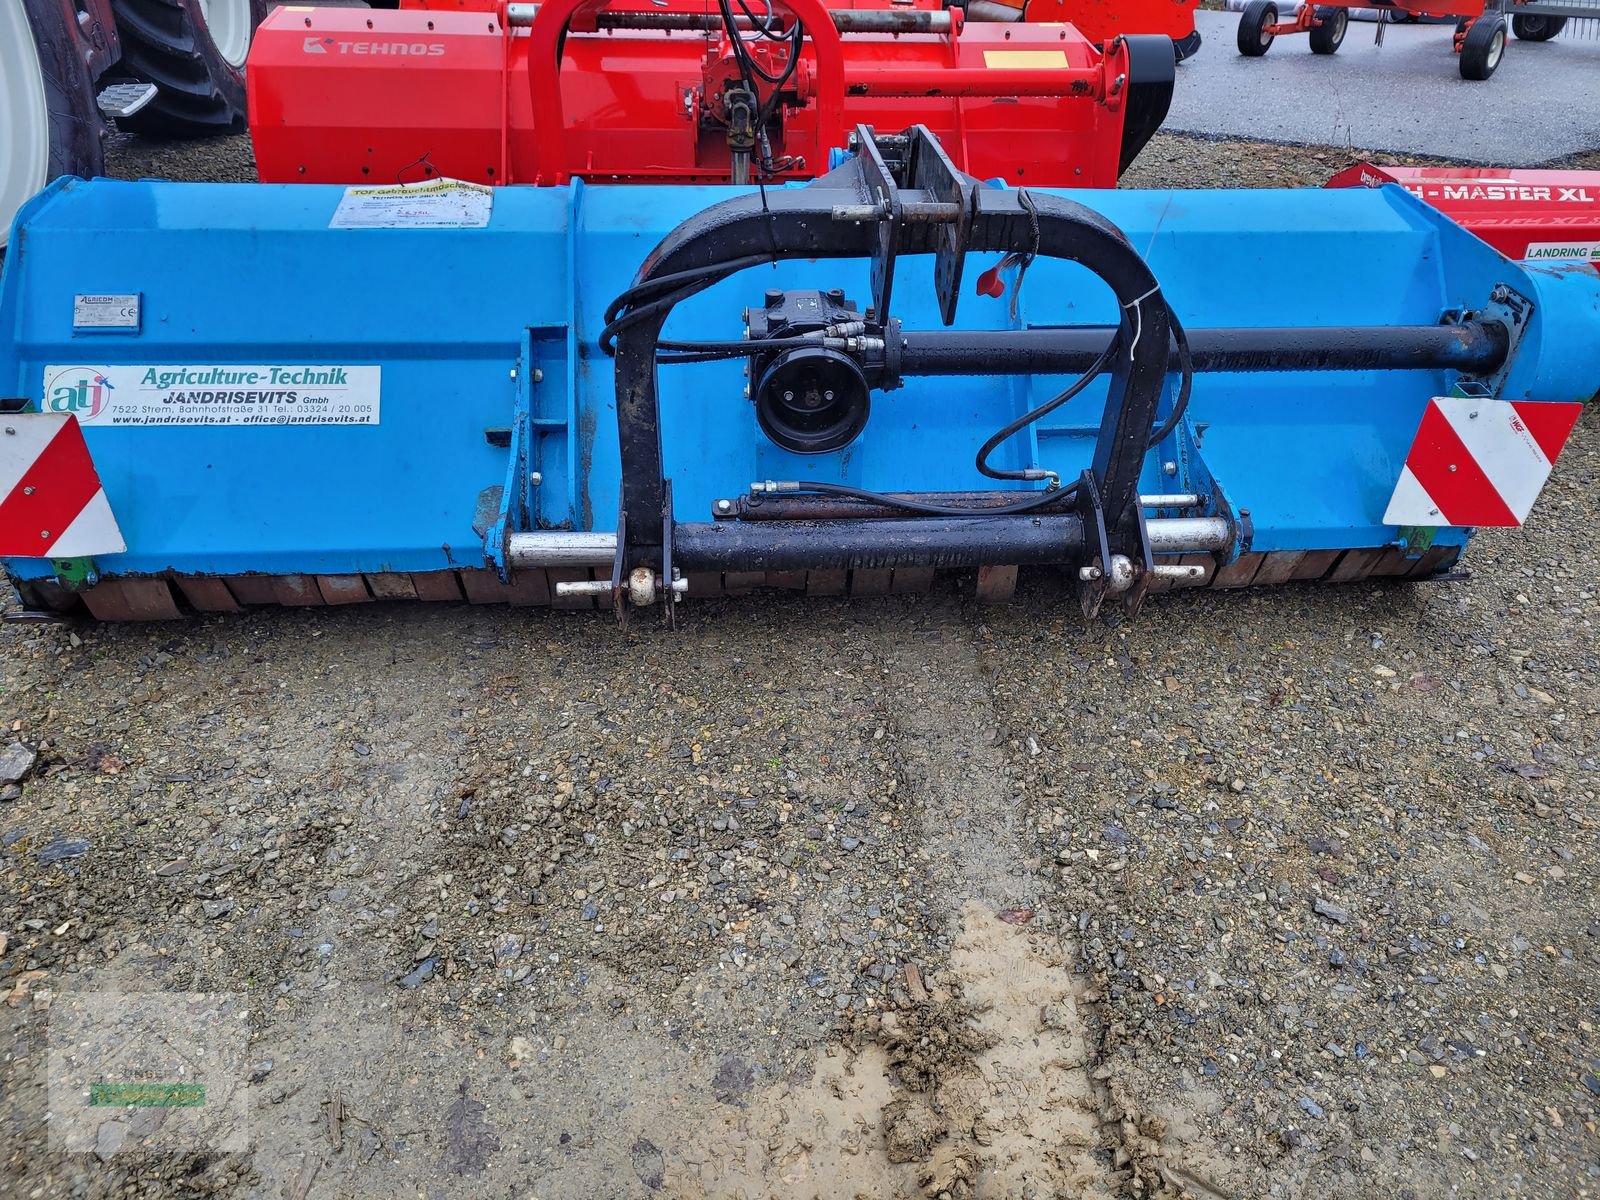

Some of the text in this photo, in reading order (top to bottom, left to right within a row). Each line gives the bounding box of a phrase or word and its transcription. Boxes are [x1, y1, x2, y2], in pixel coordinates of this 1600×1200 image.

[338, 42, 446, 56] TEHNOS
[1443, 186, 1551, 200] MASTER
[1557, 188, 1595, 201] XL
[1527, 248, 1588, 258] LANDRING
[140, 367, 348, 389] Agriculture-Technik
[163, 391, 329, 404] JANDRISEVITS Gmbh
[112, 405, 137, 413] 7522
[142, 405, 174, 414] Strem,
[179, 405, 253, 413] Bahnhofstraße
[257, 405, 268, 413] 31
[273, 405, 293, 413] Tel.:
[297, 405, 327, 413] 03324
[338, 405, 352, 413] 20
[354, 405, 372, 413] 005
[112, 415, 231, 424] www.jandrisevits.at
[243, 415, 370, 425] office@jandrisevits.at
